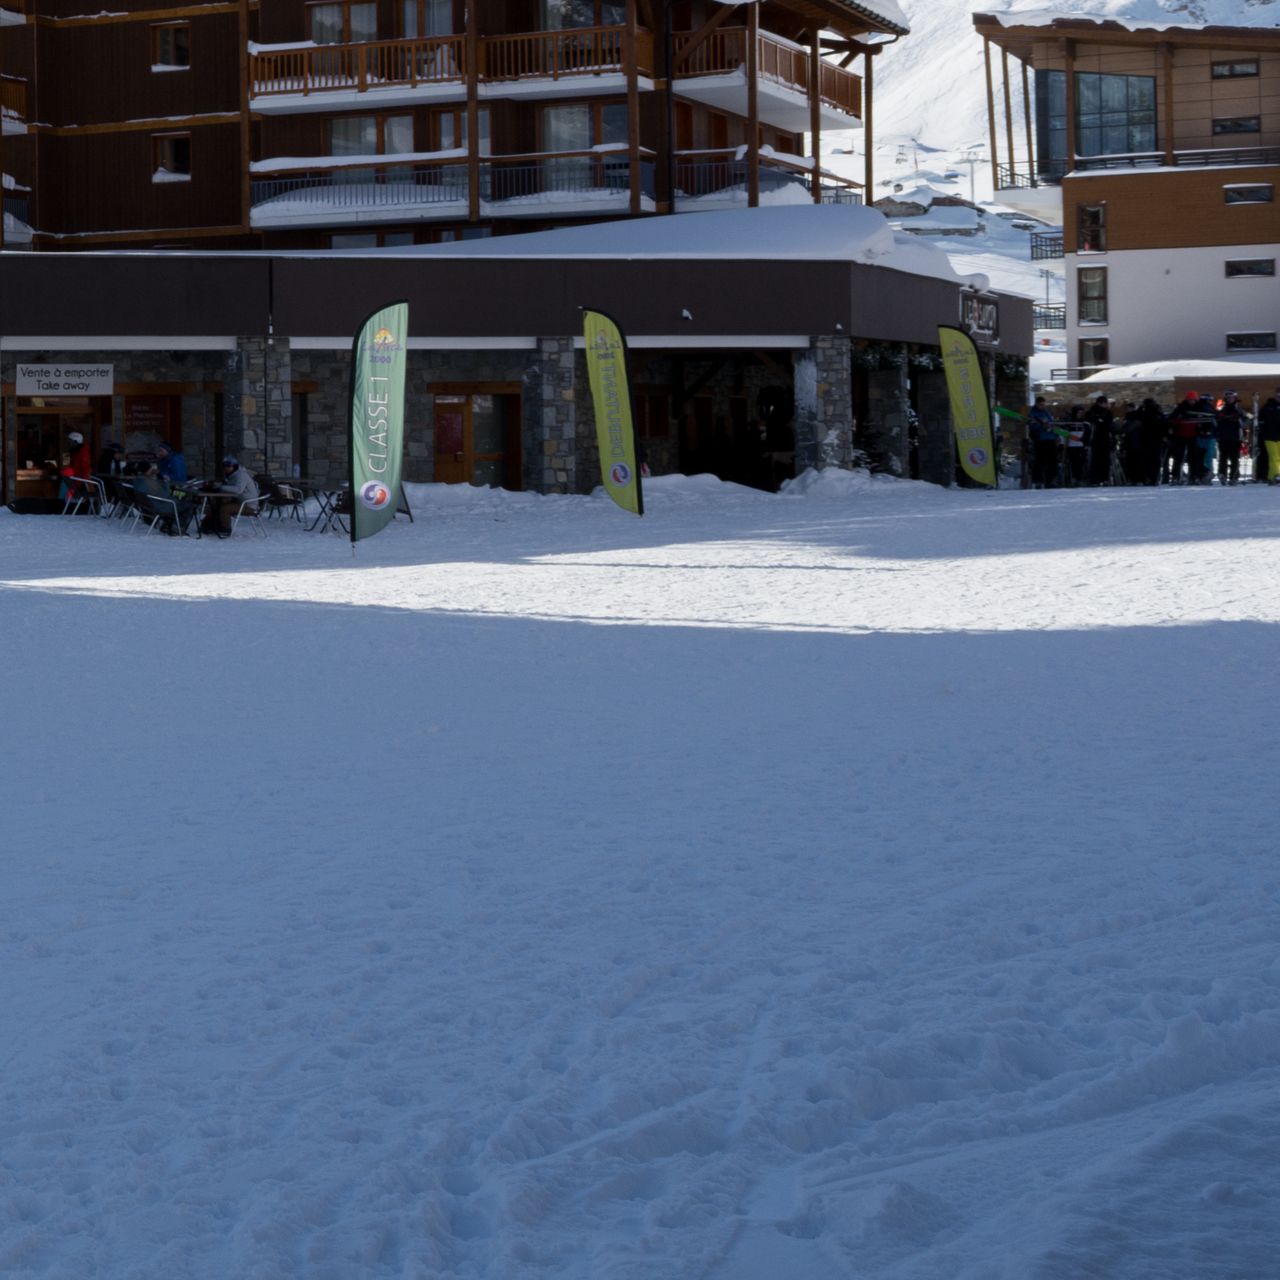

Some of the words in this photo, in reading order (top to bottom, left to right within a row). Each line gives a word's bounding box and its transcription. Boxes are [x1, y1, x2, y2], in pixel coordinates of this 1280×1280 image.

[20, 367, 51, 378] Vente
[53, 366, 62, 378] à
[64, 367, 110, 379] emporter
[36, 379, 60, 391] Take
[62, 382, 90, 392] away
[367, 392, 389, 473] CLASSE
